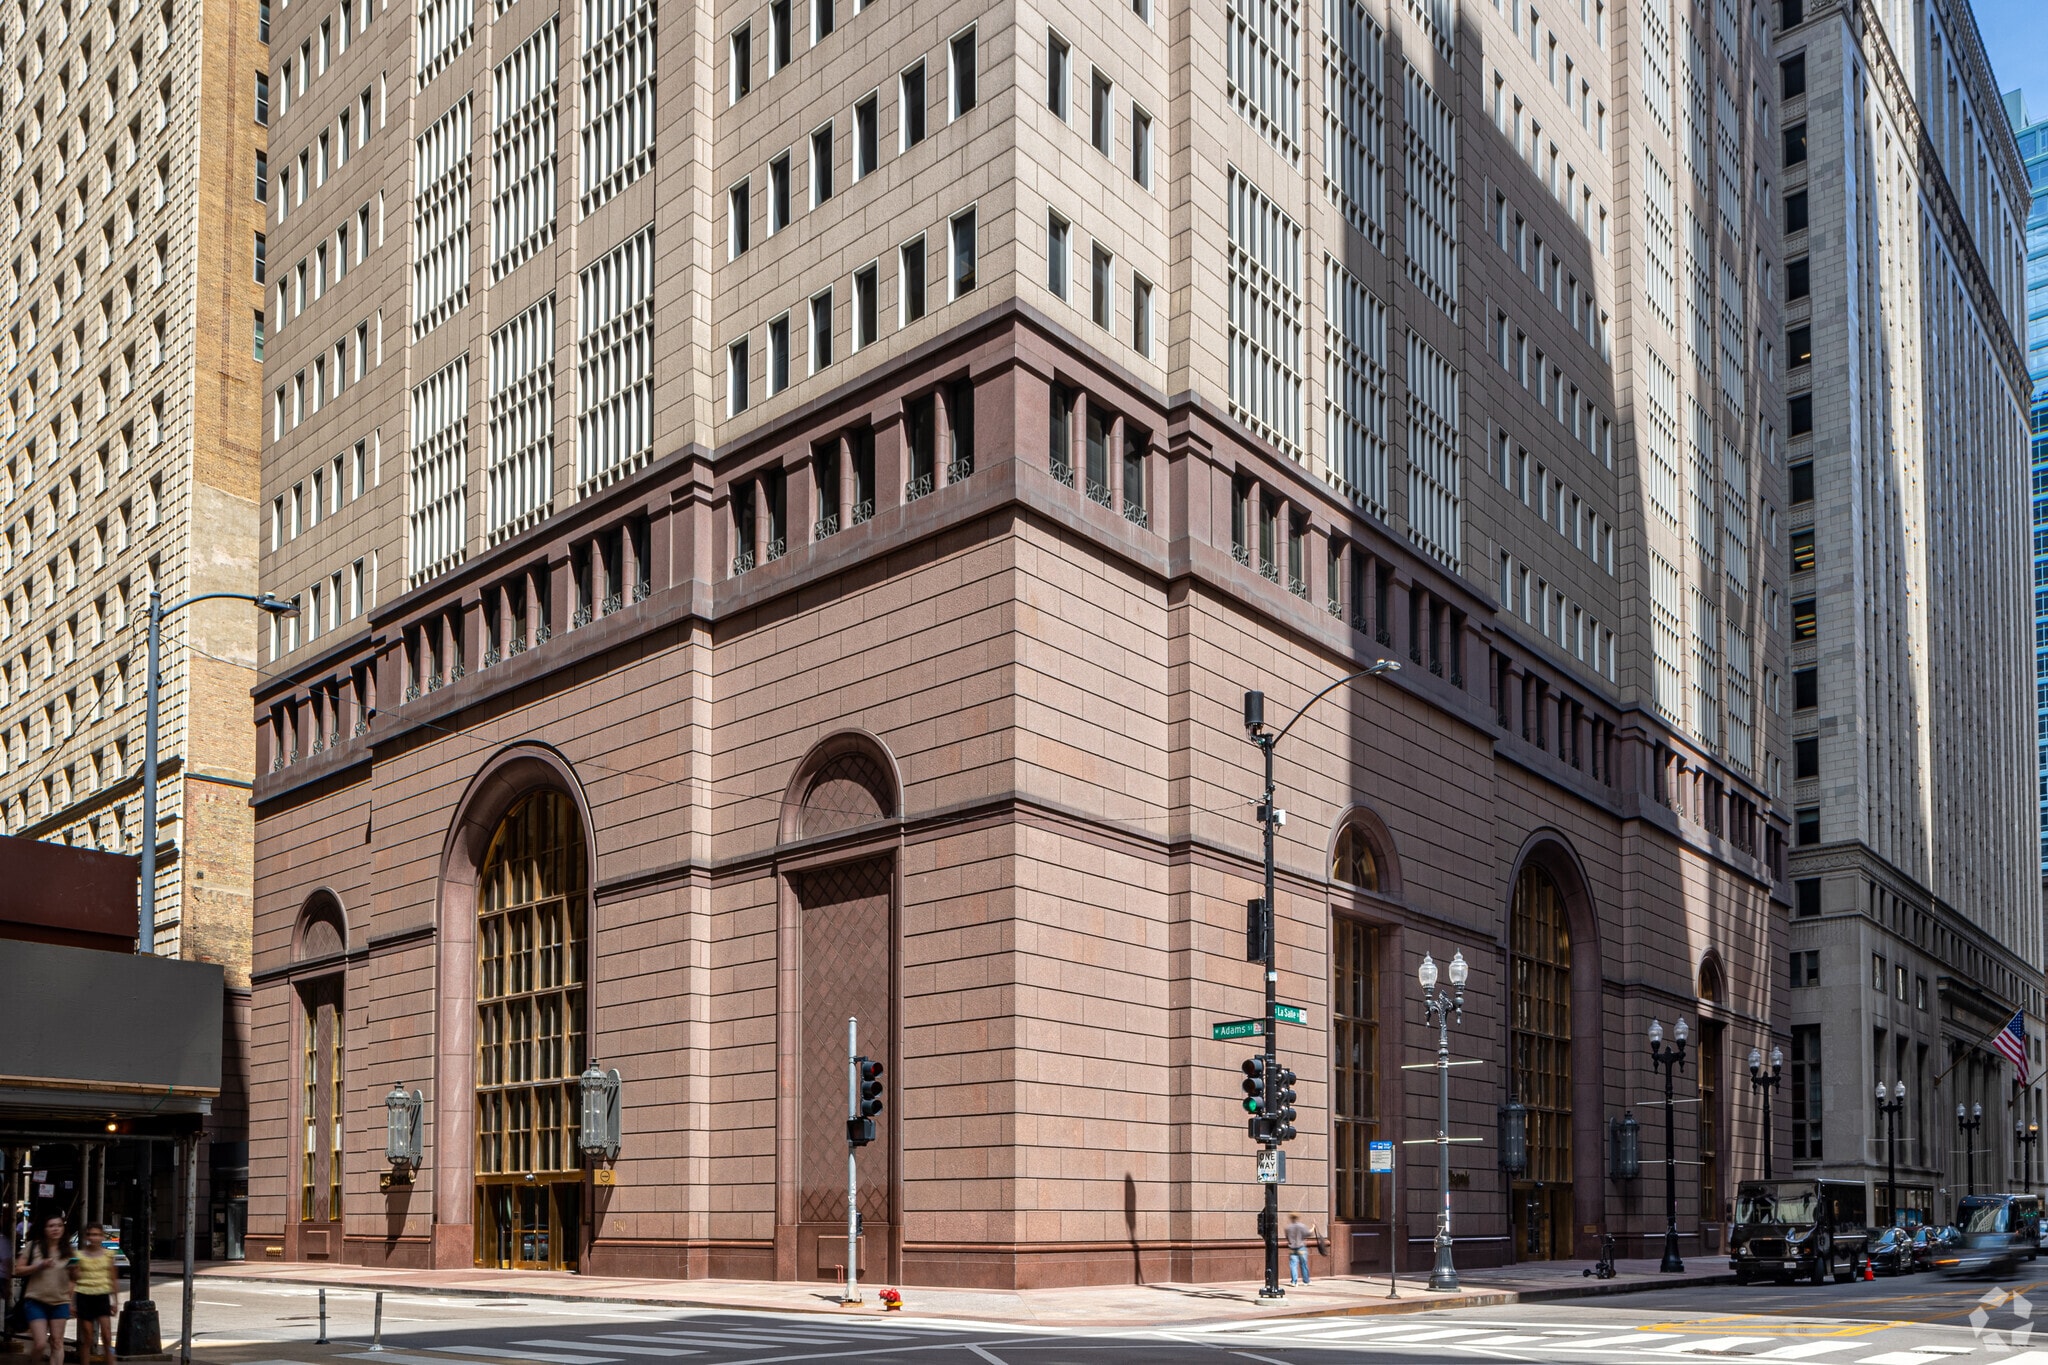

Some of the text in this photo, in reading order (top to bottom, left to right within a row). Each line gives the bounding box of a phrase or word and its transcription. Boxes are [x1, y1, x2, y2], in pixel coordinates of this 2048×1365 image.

[1220, 1025, 1246, 1035] Adams
[1259, 1152, 1275, 1160] ONE
[1259, 1161, 1275, 1169] WAY
